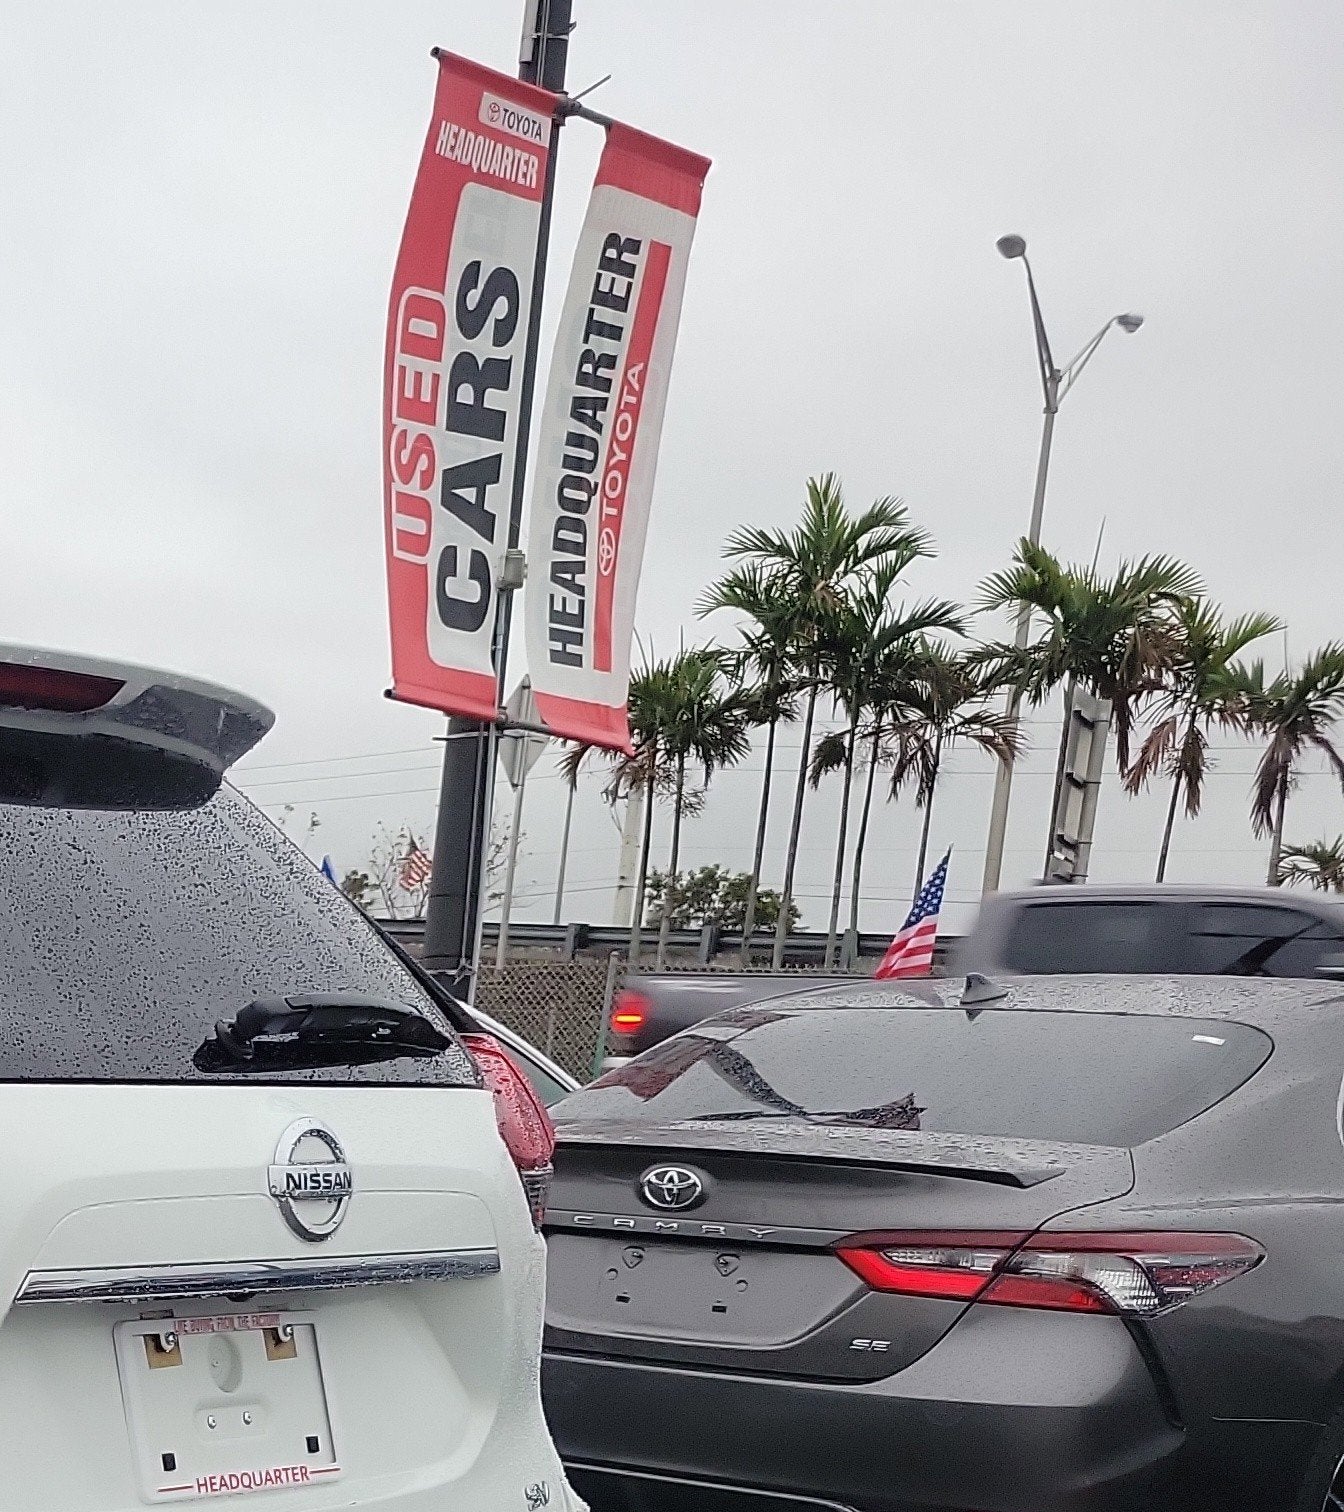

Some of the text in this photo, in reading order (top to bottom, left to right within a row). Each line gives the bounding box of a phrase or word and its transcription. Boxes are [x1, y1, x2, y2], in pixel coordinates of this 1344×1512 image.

[502, 108, 543, 141] TOYOTA
[435, 120, 539, 189] HEADQUARTER
[392, 289, 447, 562] USED
[436, 260, 520, 633] CARS
[548, 232, 642, 668] HEADQUARTER
[602, 362, 644, 521] TOYOTA
[285, 1171, 352, 1191] NISSAN
[573, 1215, 778, 1239] CAMRY
[849, 1338, 892, 1353] SE
[196, 1465, 310, 1494] HEADQUARTER
